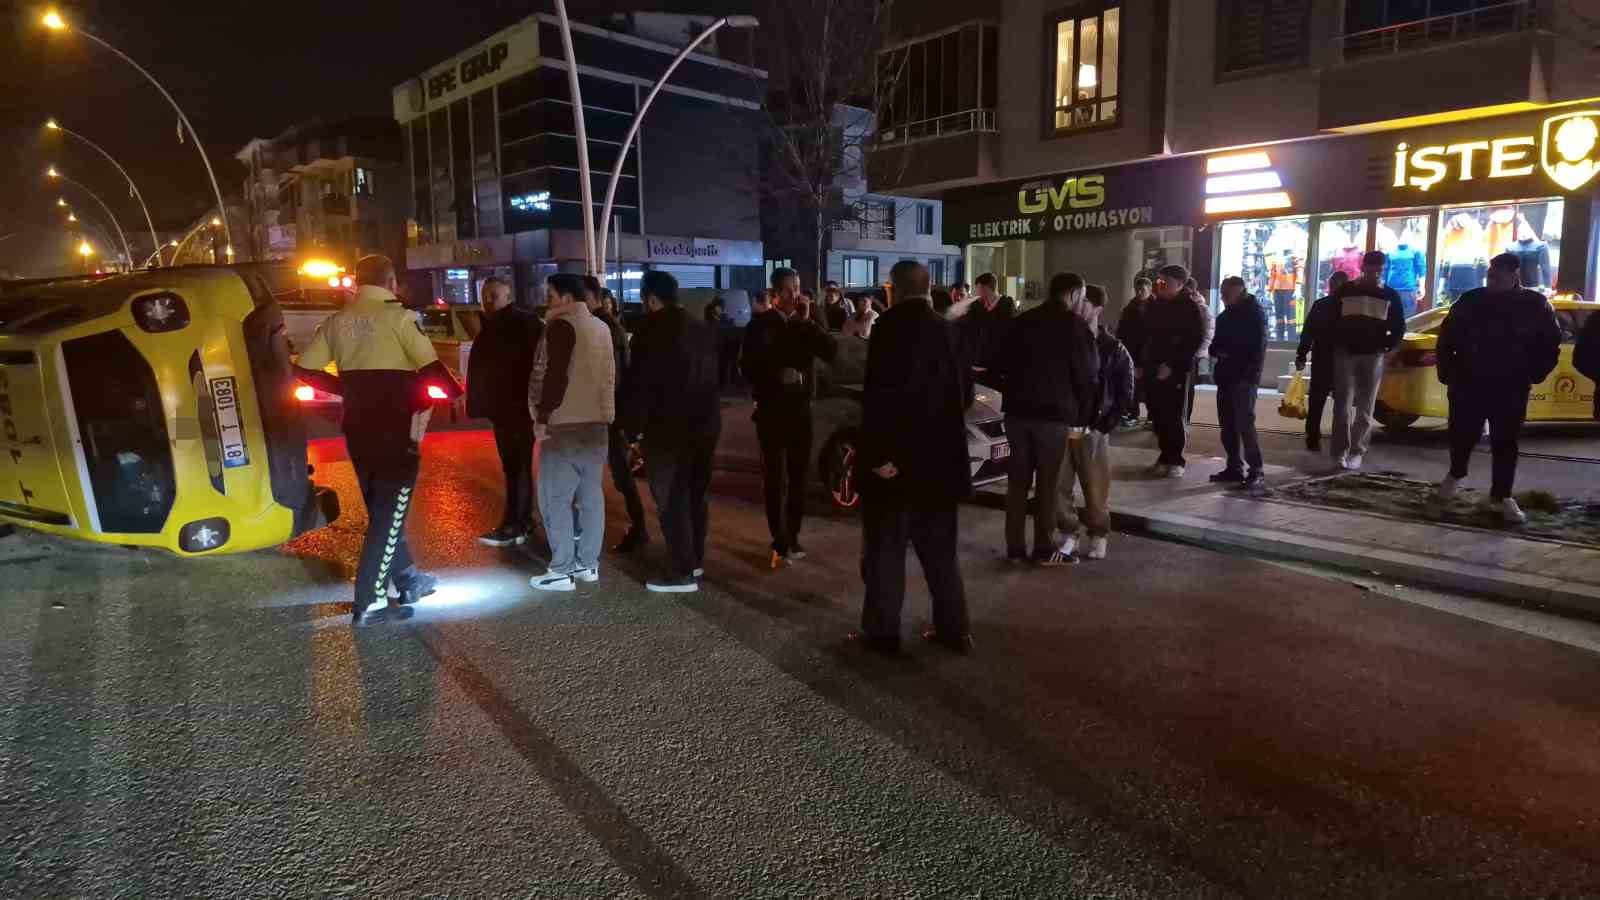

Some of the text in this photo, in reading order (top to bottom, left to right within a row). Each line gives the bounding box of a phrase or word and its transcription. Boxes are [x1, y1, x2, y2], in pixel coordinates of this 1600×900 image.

[460, 41, 509, 84] GRUP
[1392, 135, 1536, 192] İŞTE
[1018, 175, 1105, 214] GMS
[969, 206, 1153, 238] ELEKTRİK OTOMASYON
[215, 380, 235, 410] 1083
[226, 444, 242, 458] 81
